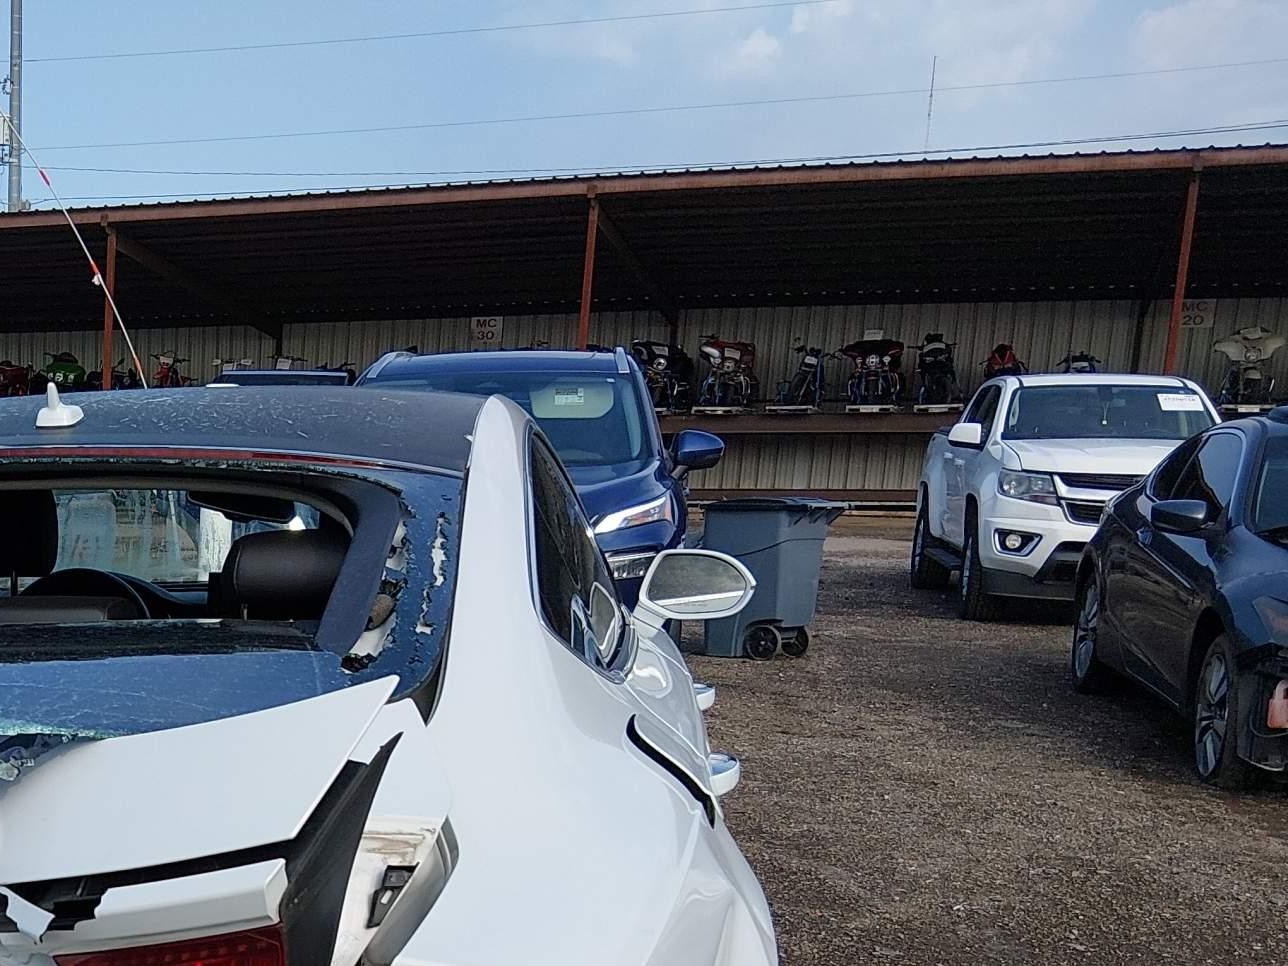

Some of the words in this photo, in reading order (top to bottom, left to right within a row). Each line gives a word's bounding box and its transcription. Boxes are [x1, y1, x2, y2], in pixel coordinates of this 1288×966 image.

[1182, 301, 1208, 312] MC
[475, 318, 497, 328] MC
[1181, 315, 1204, 326] 20
[477, 330, 495, 341] 30
